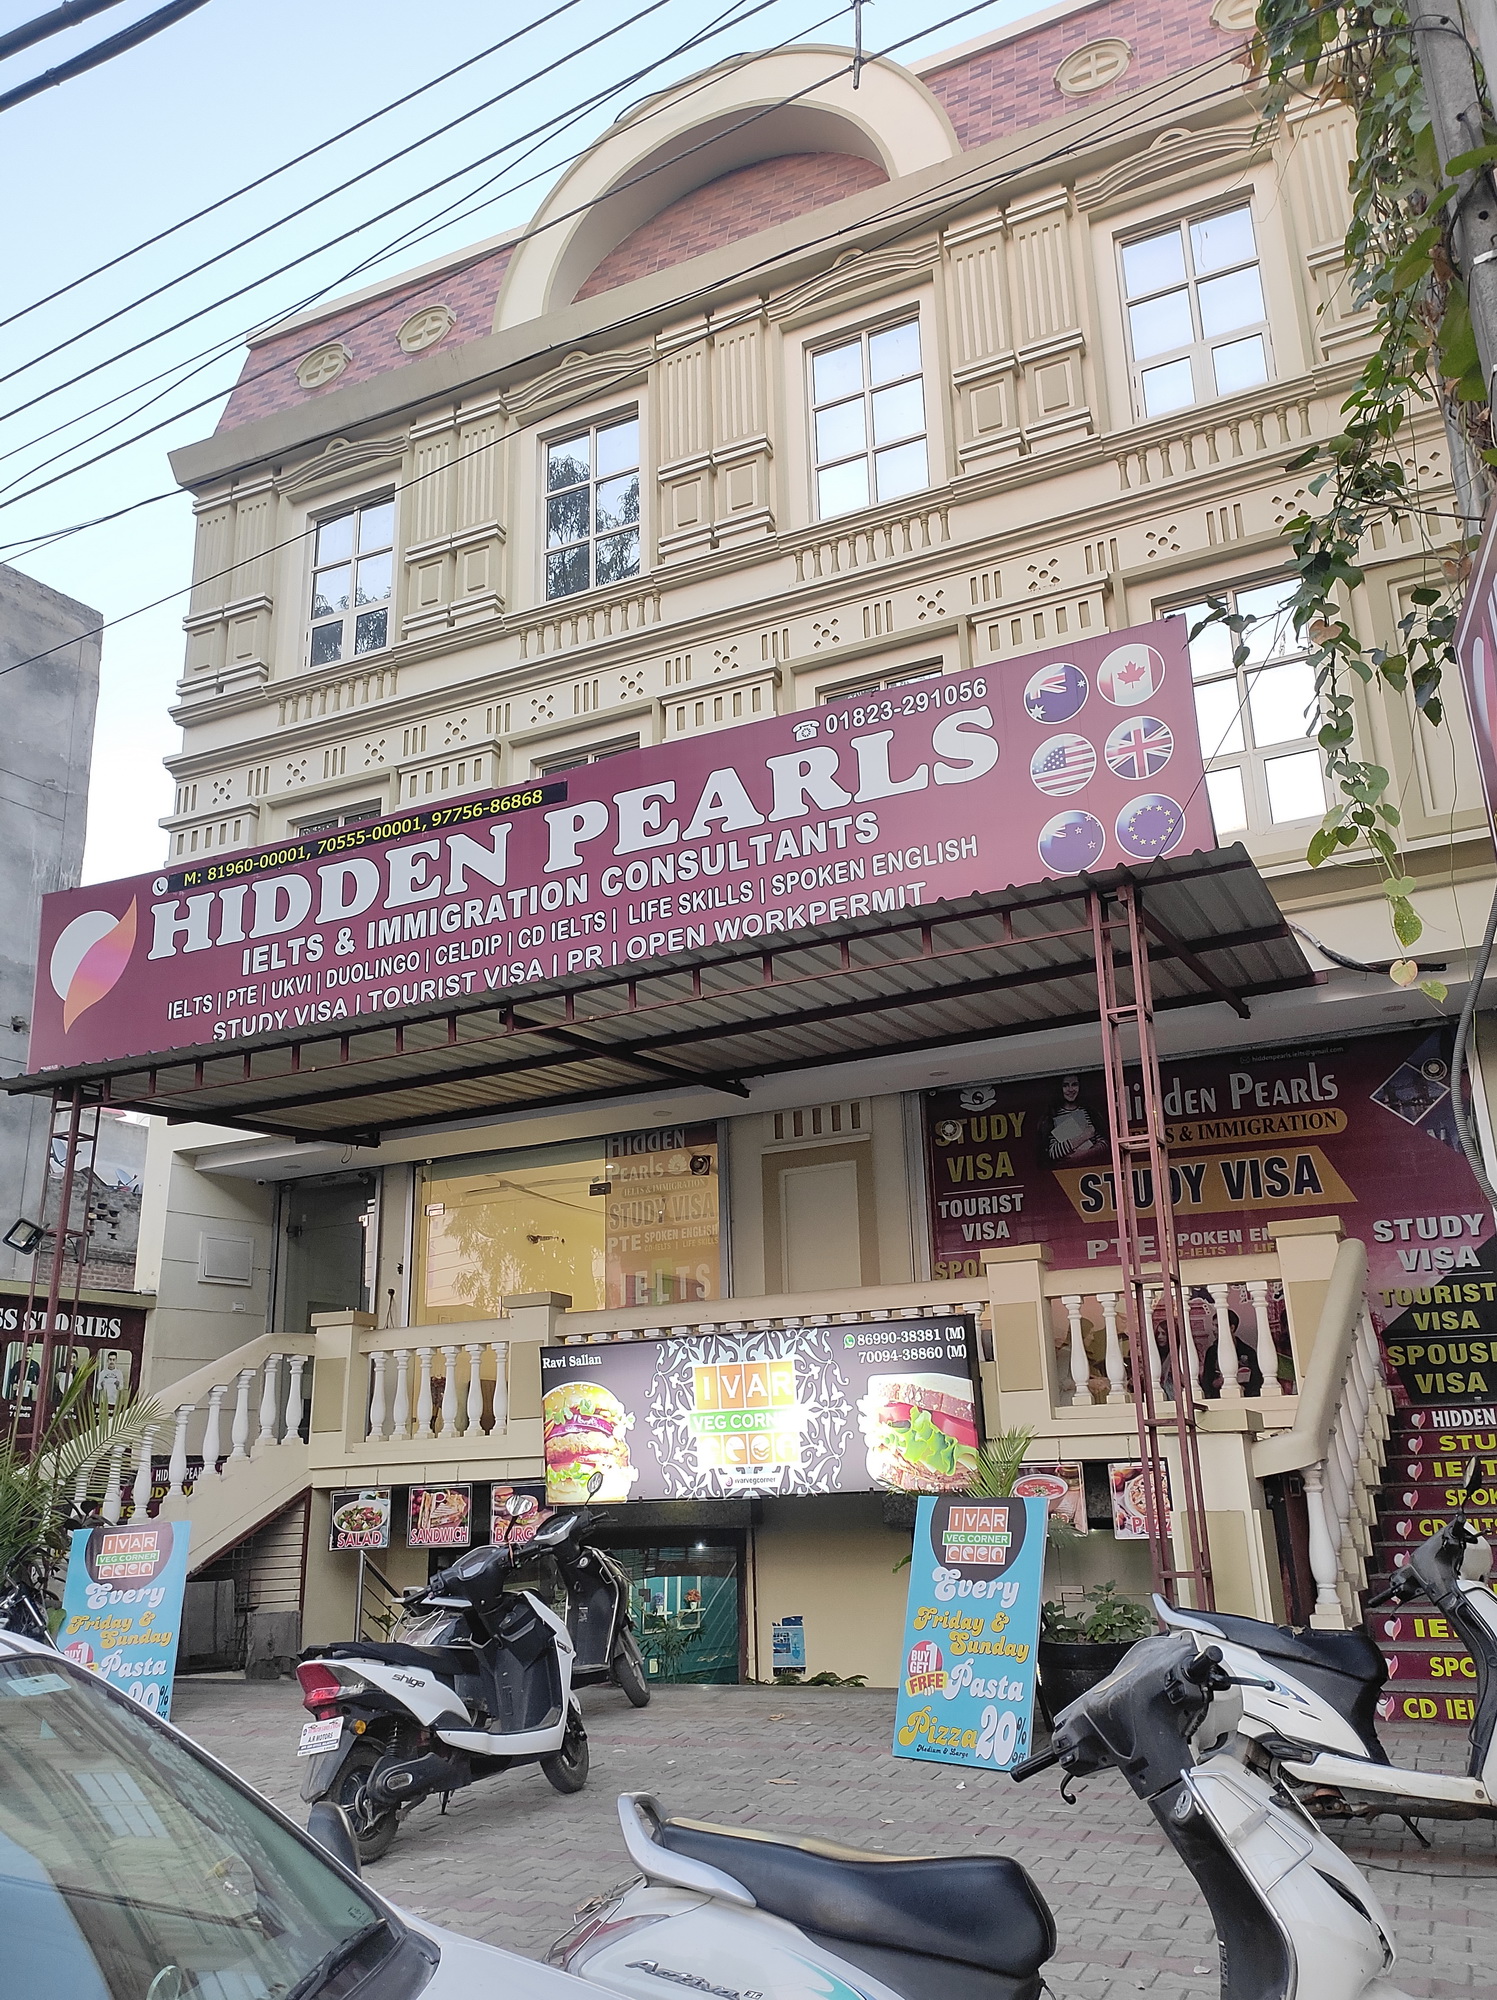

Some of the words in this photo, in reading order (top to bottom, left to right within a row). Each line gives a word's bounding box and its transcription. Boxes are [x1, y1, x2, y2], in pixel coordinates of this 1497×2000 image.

[825, 678, 987, 734] 01823-291056
[147, 822, 513, 961] HIDDEN
[543, 705, 1000, 873] PEARLS
[184, 871, 201, 887] M:
[431, 789, 543, 827] 97756-86868
[241, 934, 324, 976] IELTS
[334, 927, 356, 956] &
[366, 874, 588, 950] IMMIGRATION
[600, 811, 880, 897] CONSULTANTS
[167, 994, 213, 1020] IELTS
[226, 985, 258, 1009] PTE
[271, 973, 312, 1000] UKVI
[325, 951, 420, 989] DUOLINGO
[435, 934, 502, 965] CELDIP
[518, 925, 545, 949] CD
[551, 911, 606, 942] IELTS
[628, 897, 673, 925] LIFE
[678, 881, 753, 915] SKILLS
[771, 857, 865, 897] SPOKEN
[872, 834, 978, 877] ENGLISH
[212, 1009, 288, 1041] STUDY
[293, 997, 348, 1026] VISA
[368, 971, 477, 1012] TOURIST
[483, 958, 544, 989] VISA
[567, 945, 603, 972] PR
[626, 924, 706, 960] OPEN
[935, 1111, 1027, 1147] STUDY
[1198, 1111, 1338, 1140] IMMIGRATION
[947, 1151, 1015, 1183] VISA
[1220, 1154, 1324, 1201] VISA
[624, 1187, 645, 1197] IELTS
[652, 1178, 706, 1192] IMMIGRATION
[609, 1197, 666, 1232] STUDY
[672, 1190, 716, 1222] VISA
[938, 1193, 1024, 1219] TOURIST
[607, 1234, 642, 1254] PTE
[644, 1229, 679, 1243] SPOKEN
[681, 1223, 718, 1240] ENGLISH
[961, 1220, 1010, 1242] VISA
[1177, 1229, 1243, 1247] POKEN
[1373, 1213, 1484, 1242] STUDY
[1397, 1245, 1481, 1272] VISA
[620, 1263, 712, 1306] IELTS
[1379, 1283, 1497, 1307] TOURIST
[22, 1310, 121, 1339] STORIES
[1412, 1310, 1480, 1331] VISA
[857, 1329, 941, 1346] 86990-38381
[945, 1326, 965, 1342] (M)
[542, 1356, 566, 1369] Ravi
[569, 1354, 602, 1367] Sallan
[858, 1346, 943, 1364] 70094-38860
[947, 1344, 967, 1360] (M)
[703, 1371, 792, 1401] IVAR
[1414, 1371, 1488, 1394] VISA
[693, 1415, 727, 1431] VEG
[1431, 1408, 1497, 1428] HIDDEN
[954, 1513, 1006, 1527] IVAR
[108, 1536, 155, 1550] IVAR
[338, 1530, 382, 1548] SALAD
[410, 1526, 468, 1544] SANDWICH
[946, 1534, 966, 1543] VEG
[967, 1534, 1009, 1544] CORNER
[100, 1555, 118, 1563] VEG
[119, 1552, 157, 1562] CORNER
[85, 1583, 165, 1610] Every
[932, 1566, 1020, 1609] Every
[66, 1614, 132, 1635] Friday
[139, 1611, 156, 1627] &
[913, 1606, 985, 1637] Friday
[990, 1611, 1010, 1634] &
[100, 1630, 173, 1650] Sunday
[949, 1630, 1030, 1664] Sunday
[98, 1649, 167, 1680] Pasta
[909, 1661, 929, 1674] GET
[911, 1650, 930, 1662] BUY
[926, 1641, 938, 1672] 1
[909, 1673, 945, 1695] FREE
[942, 1658, 1024, 1702] Pasta
[1403, 1698, 1438, 1719] CD
[898, 1706, 979, 1749] Pizza
[917, 1744, 941, 1754] Medium
[950, 1749, 969, 1759] Large
